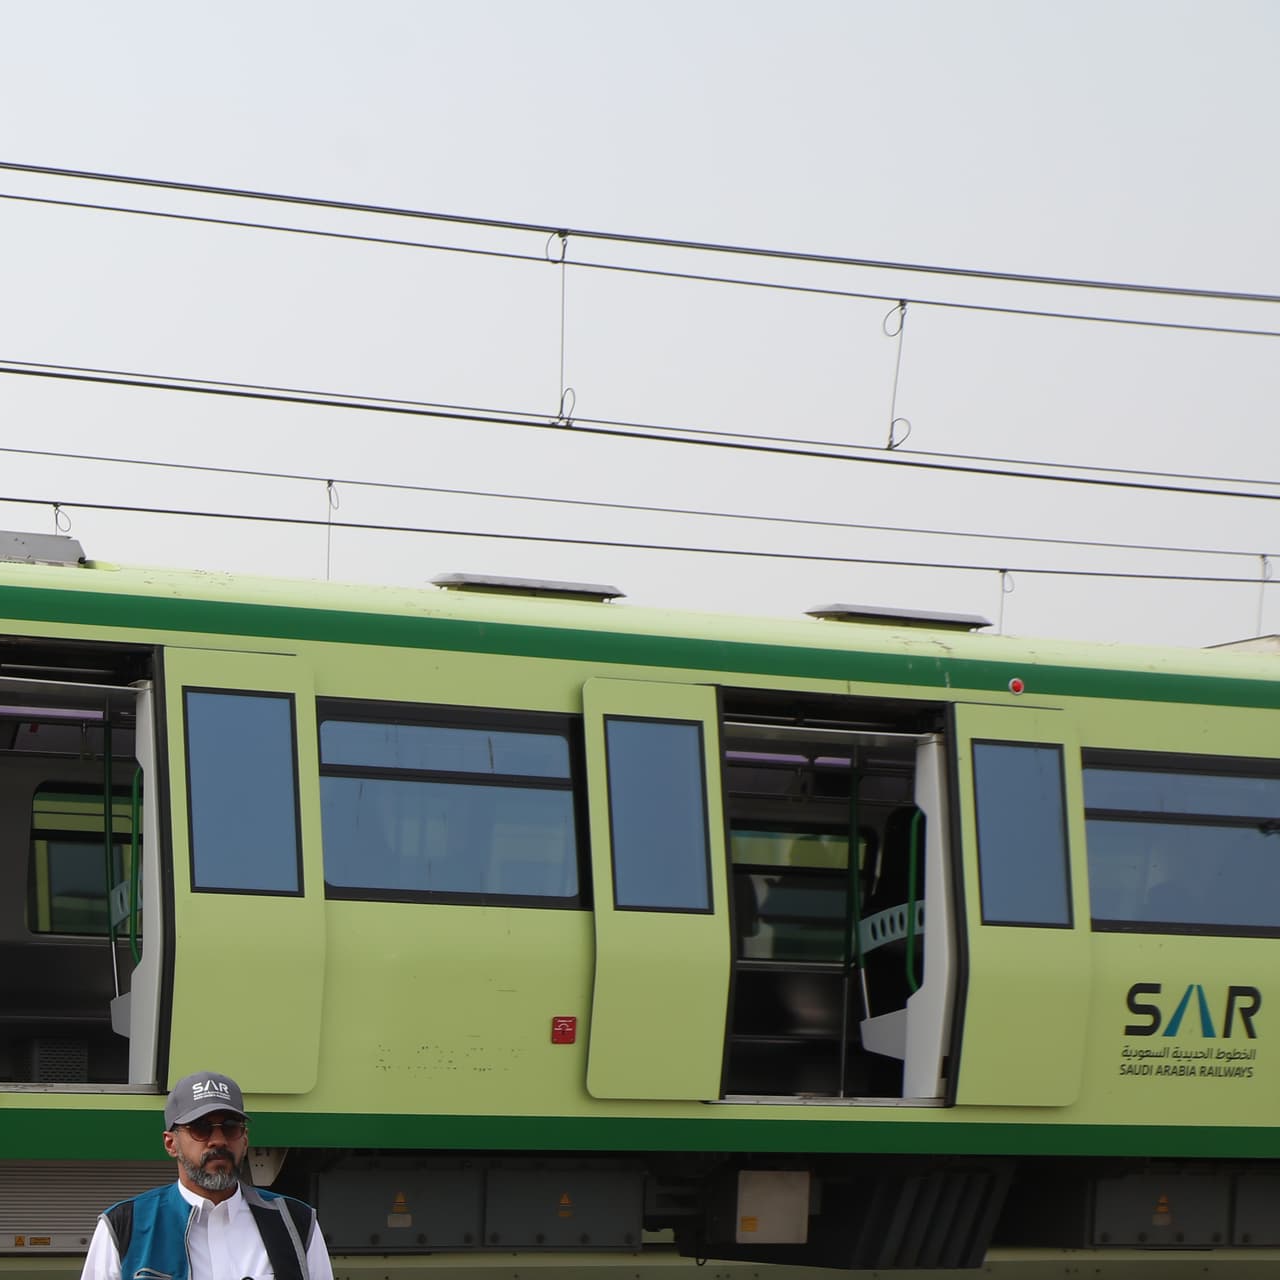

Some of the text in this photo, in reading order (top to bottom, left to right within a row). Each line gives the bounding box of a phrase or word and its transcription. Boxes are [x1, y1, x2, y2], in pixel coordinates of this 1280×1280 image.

[1124, 982, 1262, 1039] SAR
[1121, 1045, 1257, 1063] الخطوط الحديدية السعودية
[1119, 1064, 1254, 1078] SAUDI ARABIA RAILWAYS
[192, 1080, 229, 1094] SAR
